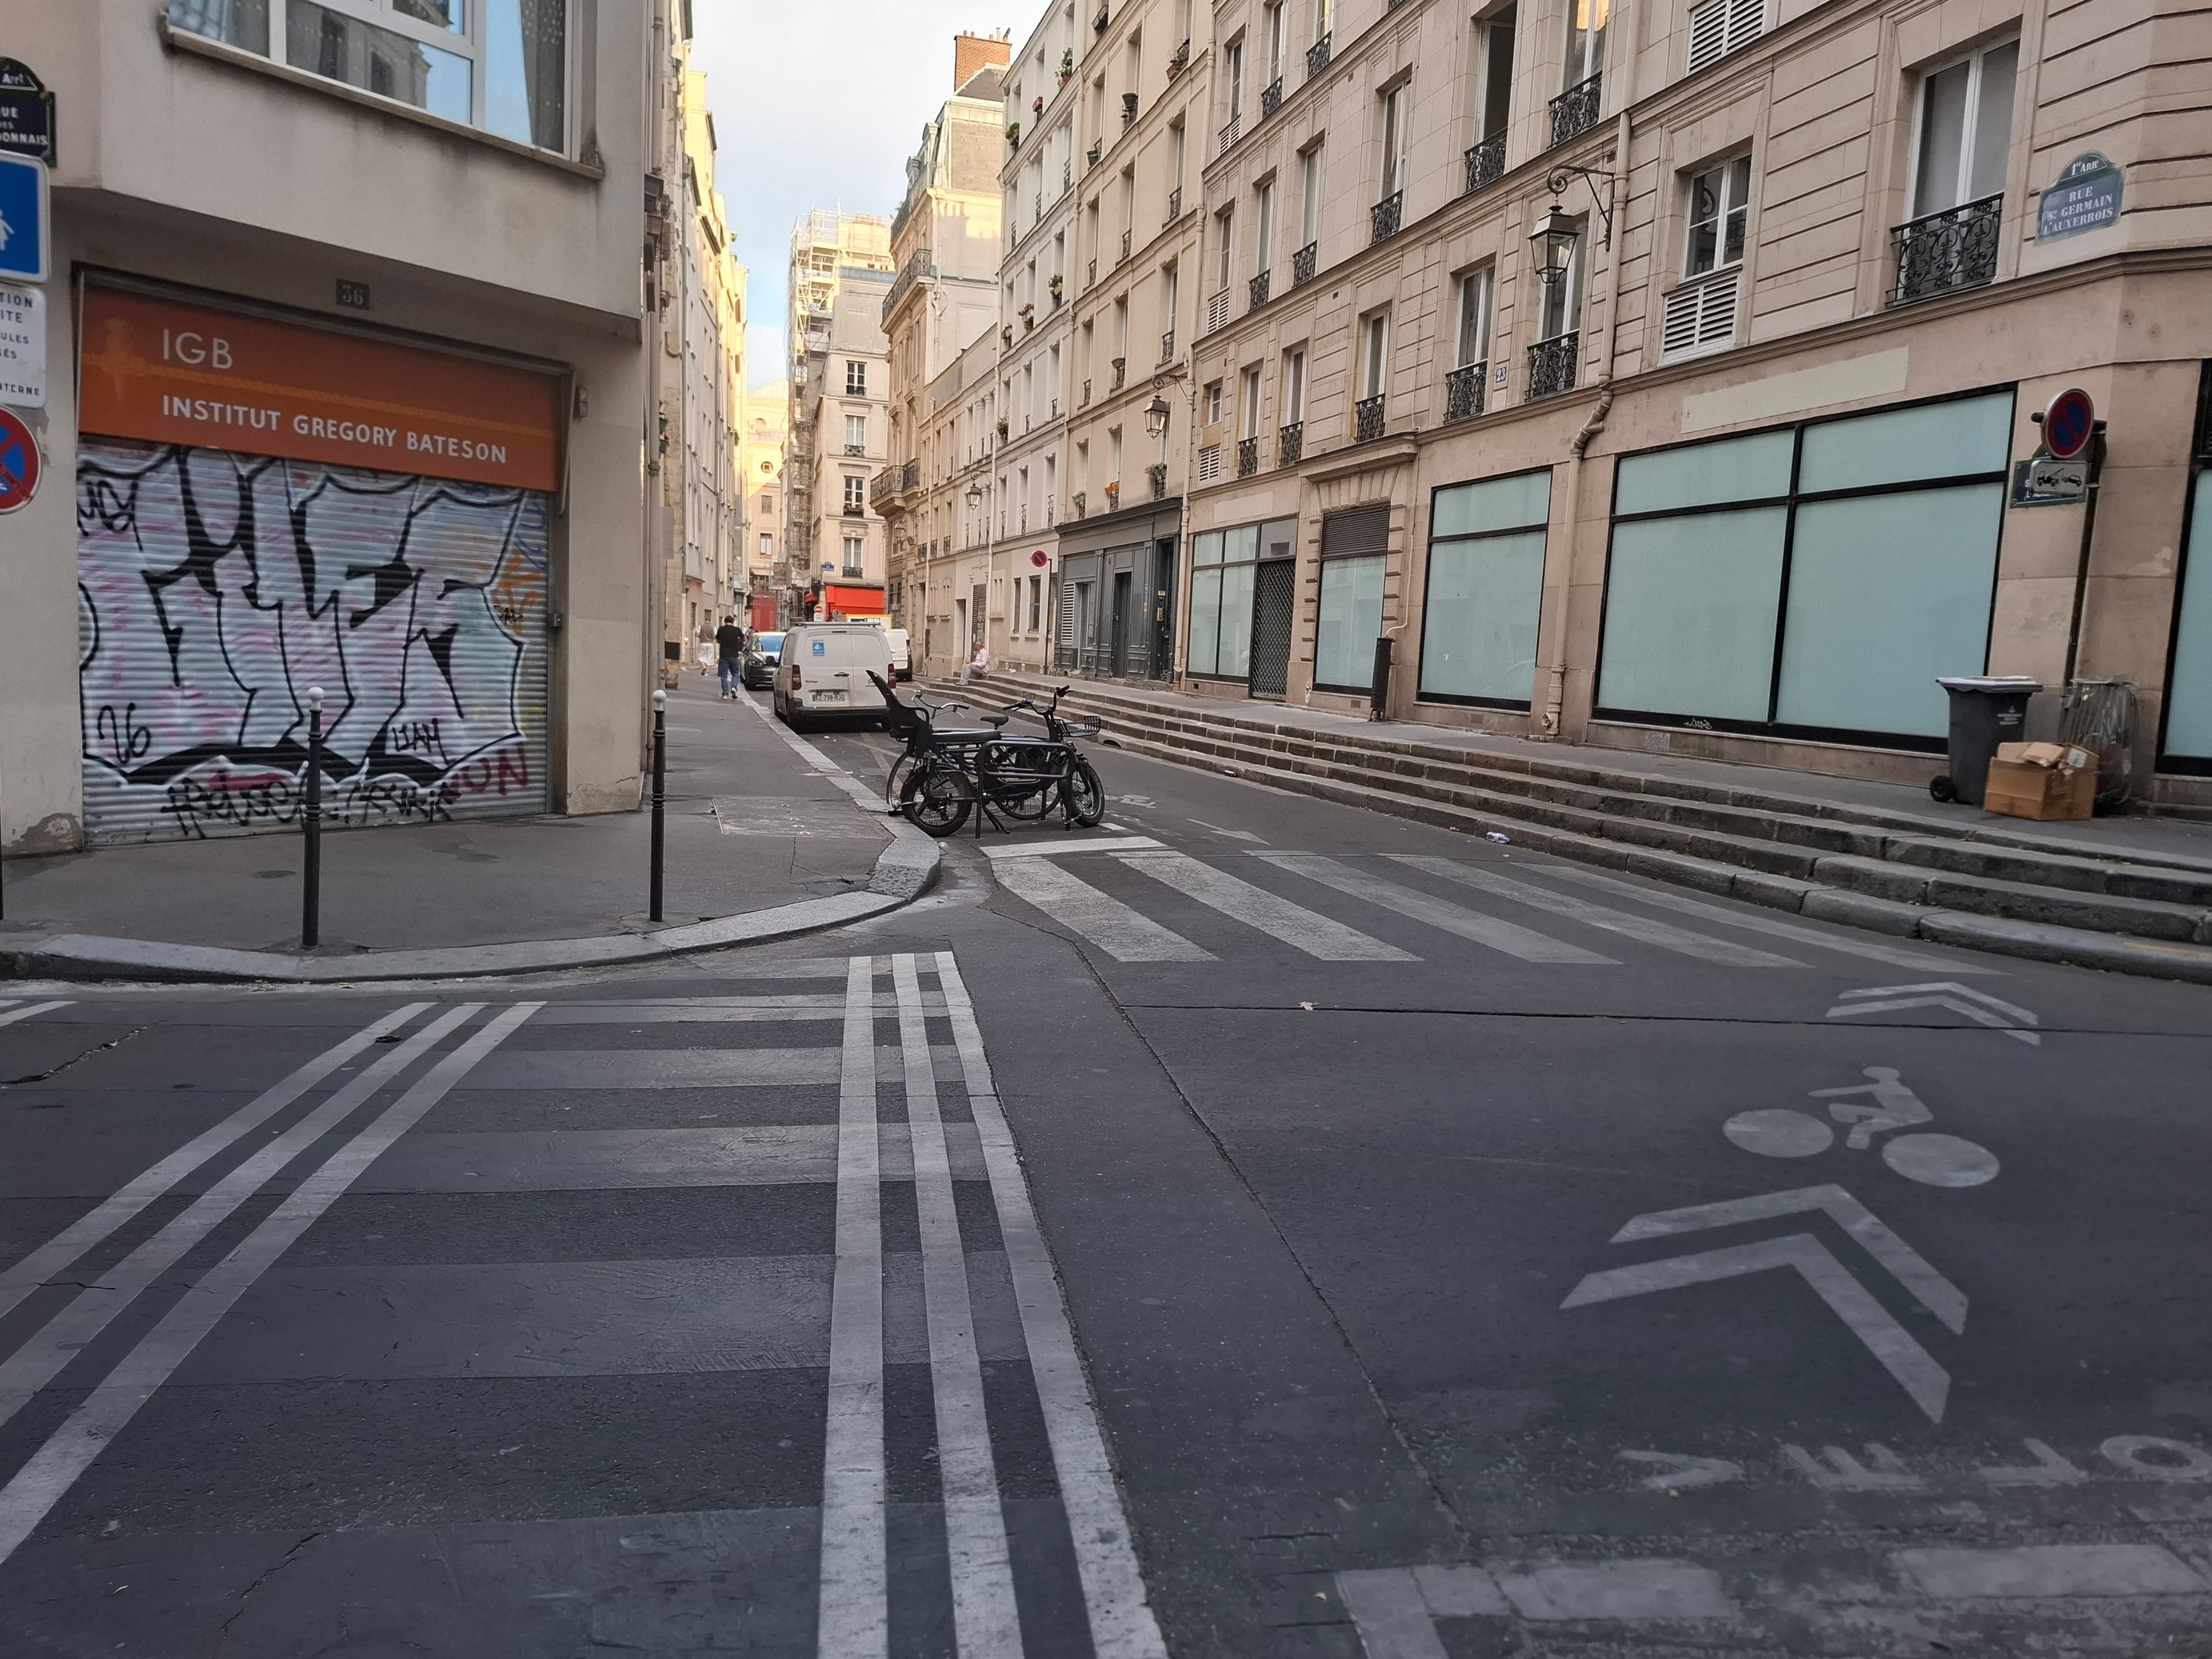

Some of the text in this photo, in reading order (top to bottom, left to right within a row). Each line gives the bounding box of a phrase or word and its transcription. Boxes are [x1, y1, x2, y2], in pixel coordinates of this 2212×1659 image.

[2061, 193, 2113, 218] GERMAIN
[2069, 186, 2093, 203] RUE
[2043, 207, 2114, 235] L'AUXERROIS
[342, 284, 364, 306] 36
[163, 328, 233, 370] IGB
[1496, 368, 1506, 382] 23
[163, 395, 506, 464] INSTITUT GREGORY BATESON
